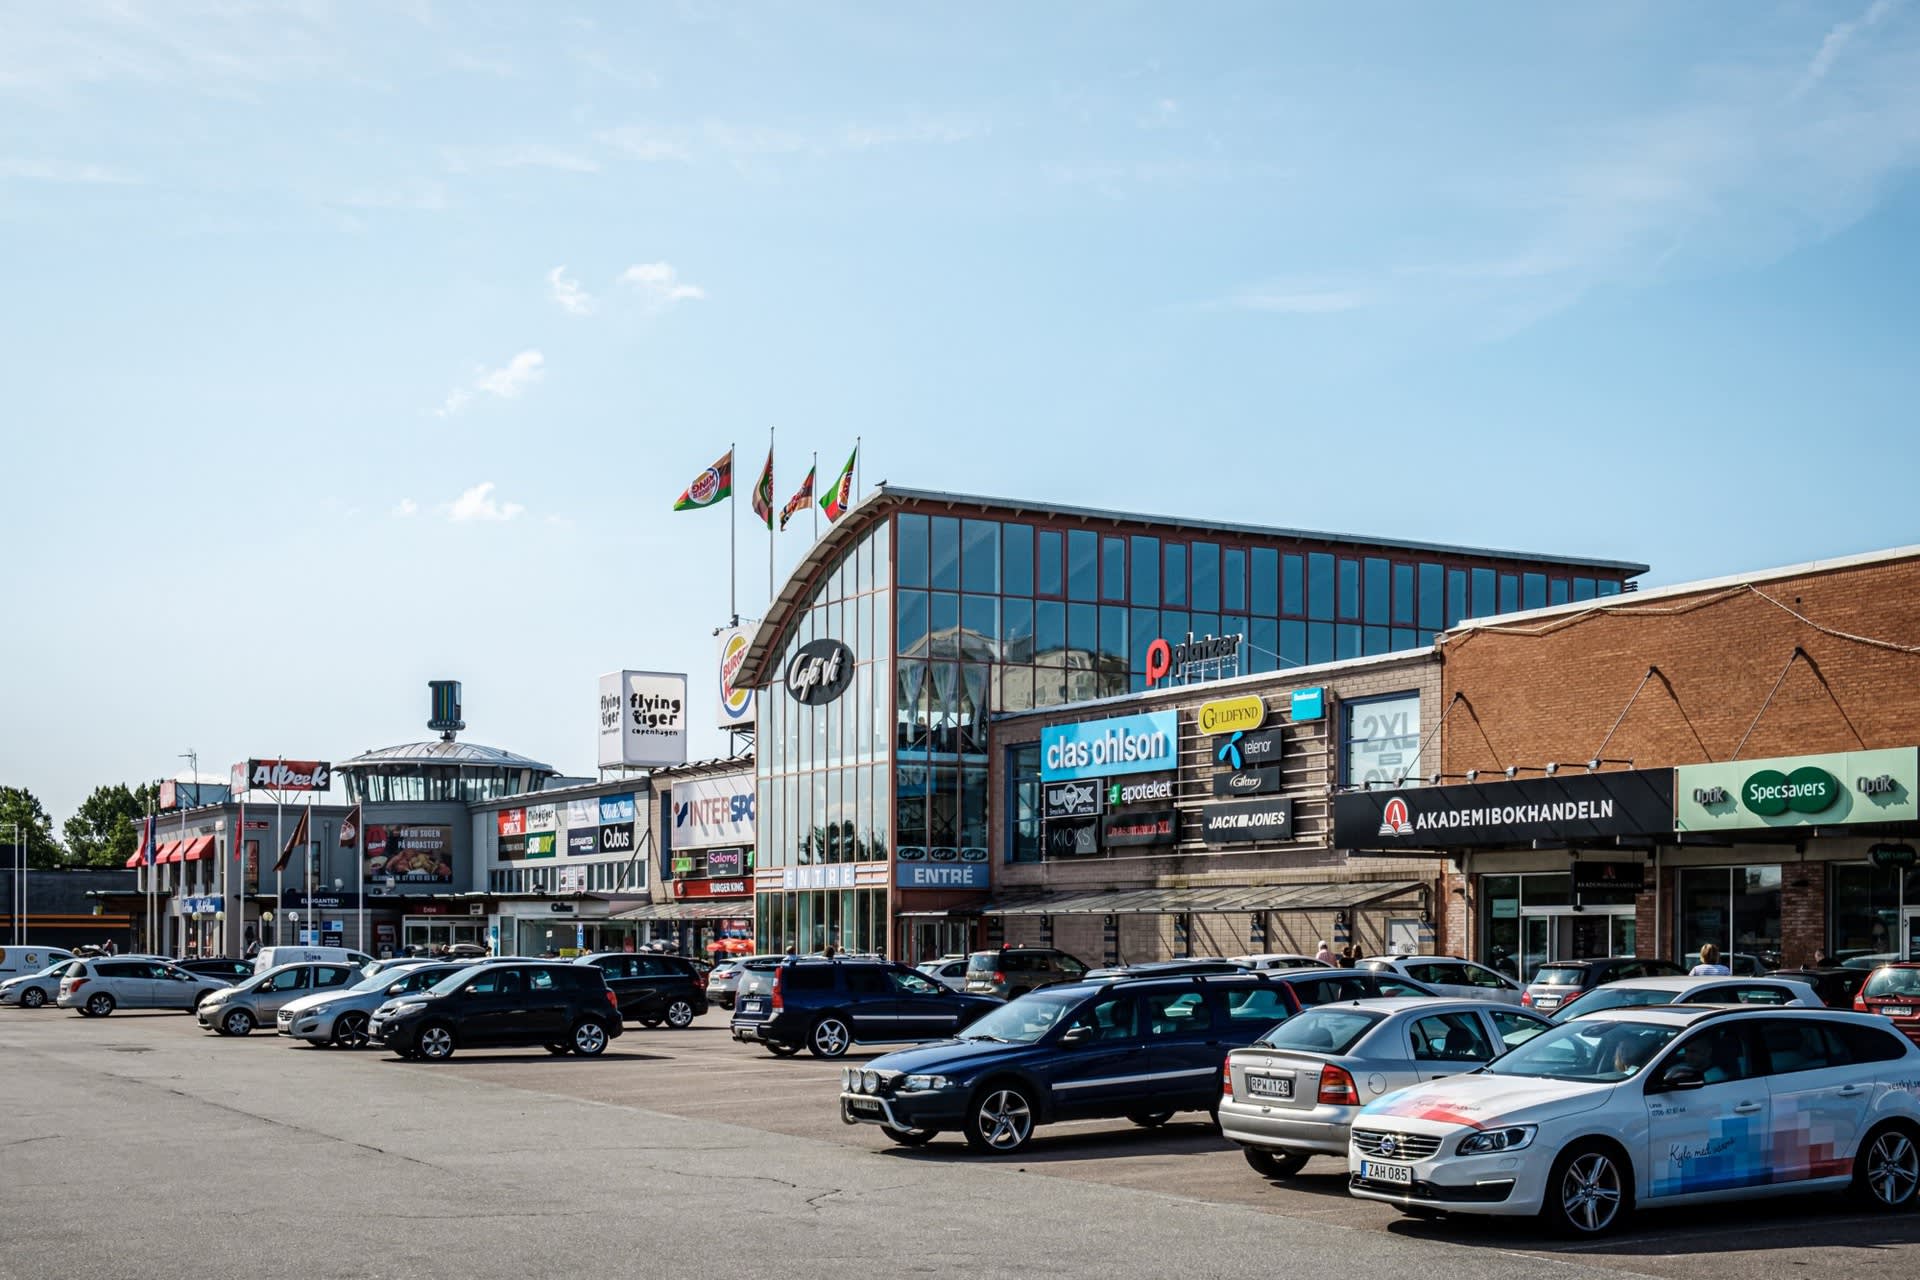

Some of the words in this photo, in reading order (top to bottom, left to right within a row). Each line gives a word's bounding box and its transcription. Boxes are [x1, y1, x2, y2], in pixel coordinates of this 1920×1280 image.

[630, 693, 681, 713] flying
[633, 709, 677, 728] tiger
[1203, 706, 1258, 729] GULDFYND
[632, 728, 678, 736] copenhagen
[1362, 712, 1417, 753] 2XL
[1047, 735, 1088, 769] clas
[1092, 728, 1165, 765] ohlson
[1244, 741, 1271, 754] telenor
[252, 765, 328, 787] Albeek
[1857, 775, 1894, 795] Optik
[1121, 780, 1172, 804] apoteket
[1694, 786, 1726, 805] Optik
[1750, 782, 1826, 803] Specsavers
[1209, 815, 1238, 830] JACK
[1249, 812, 1285, 827] JONES
[1416, 800, 1613, 830] AKADEMIBOKHANDELN
[603, 826, 629, 848] Cubus
[1053, 827, 1091, 848] KICKS
[709, 853, 737, 864] Salong
[914, 865, 973, 884] ENTRÉ
[710, 883, 729, 893] BURGER
[730, 882, 744, 892] KING
[1273, 1081, 1288, 1093] 129
[1670, 1144, 1691, 1168] Kyla
[1369, 1163, 1386, 1178] ZAH
[1388, 1166, 1407, 1181] 085
